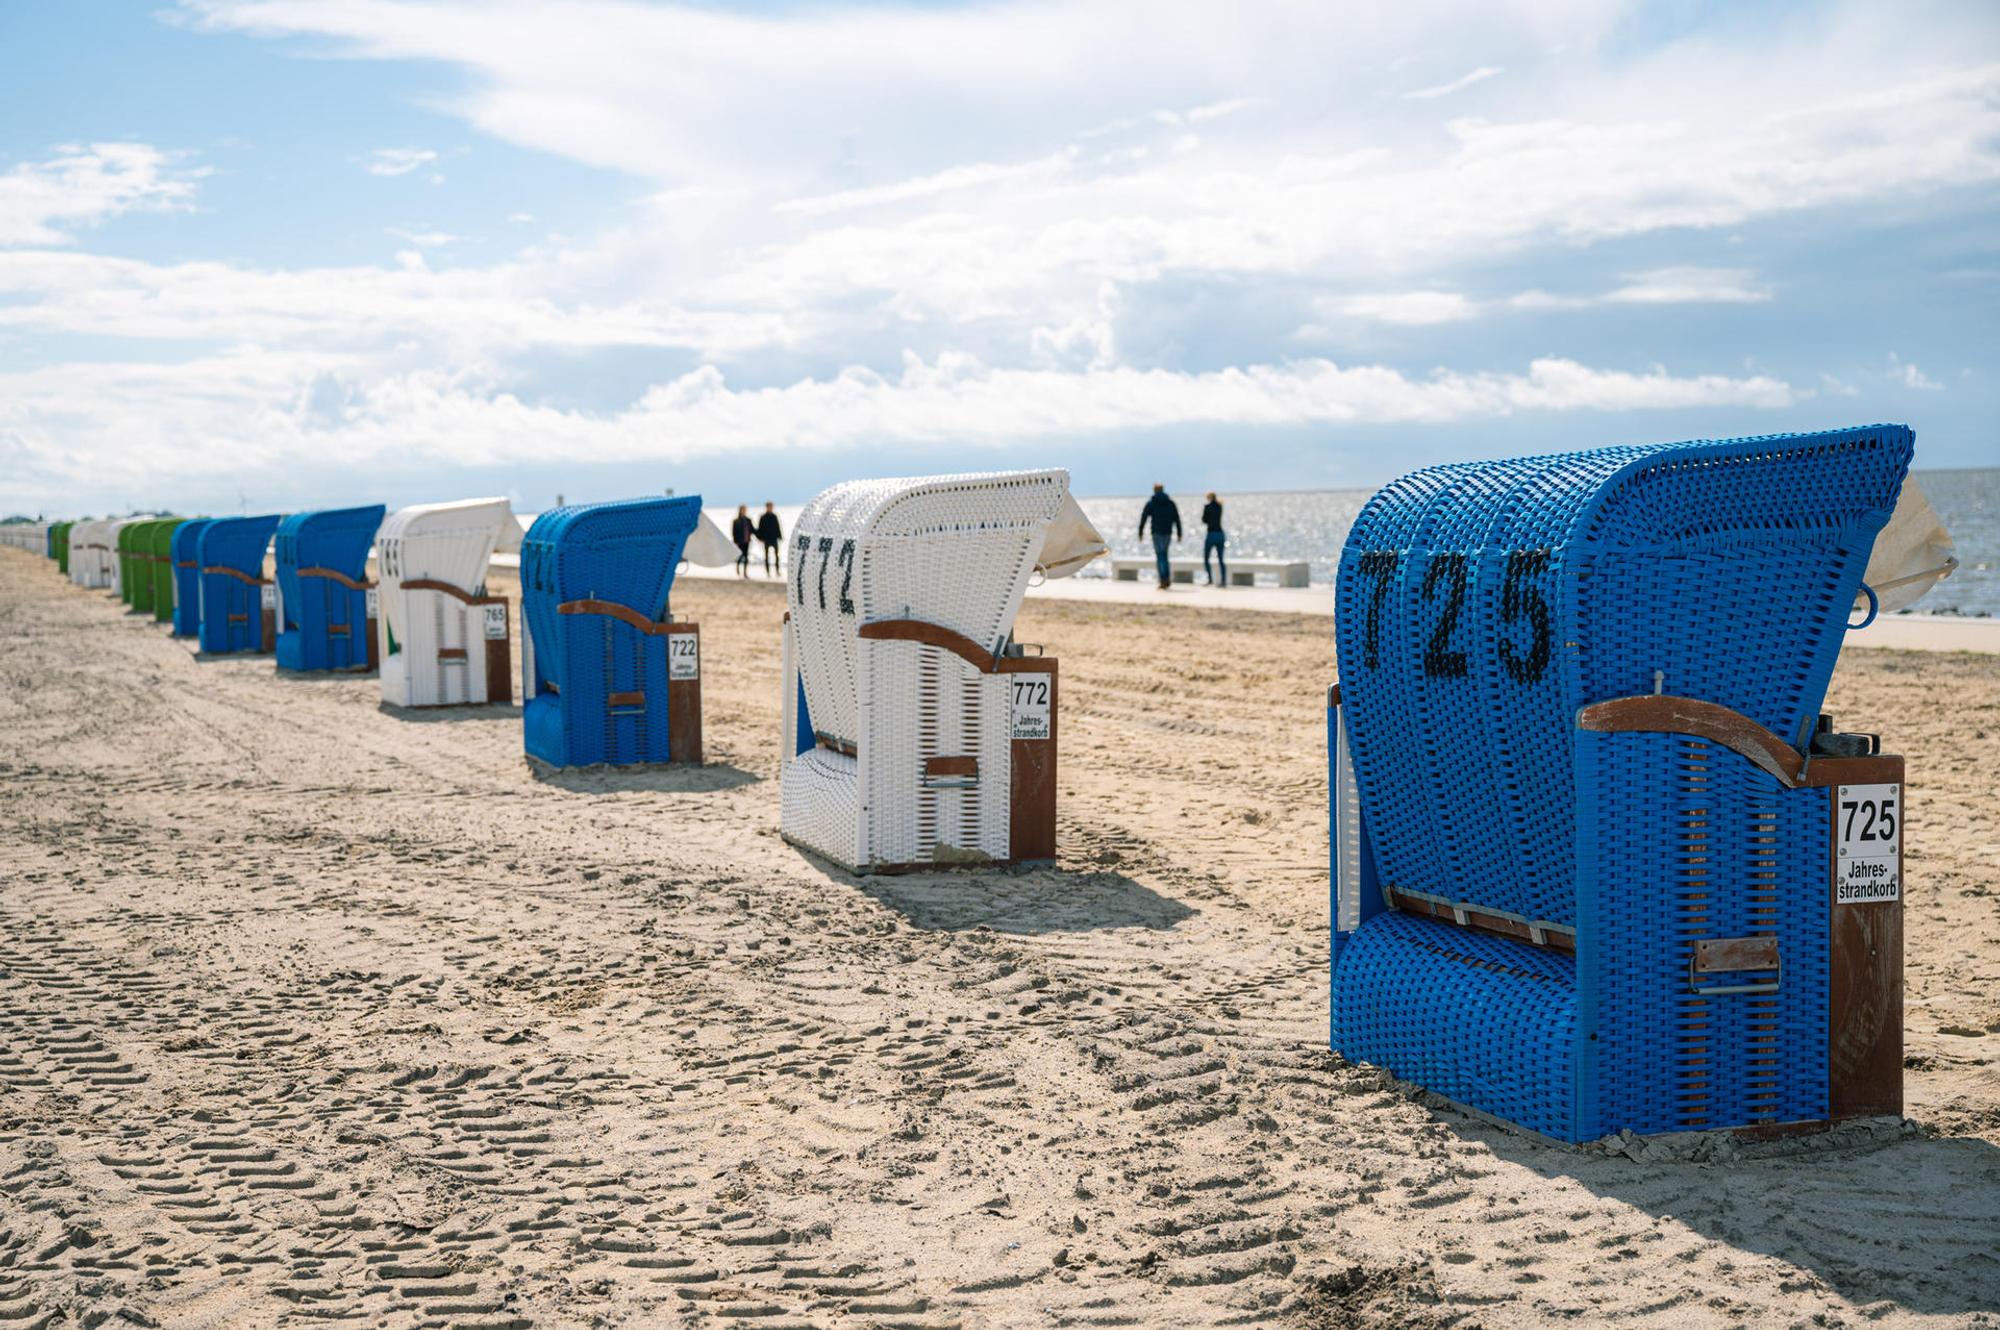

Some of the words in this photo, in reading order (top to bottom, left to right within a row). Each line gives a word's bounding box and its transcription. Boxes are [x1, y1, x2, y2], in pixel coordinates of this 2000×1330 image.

[797, 535, 854, 614] 772
[1358, 551, 1549, 682] 725
[672, 640, 695, 656] 722
[1014, 682, 1047, 705] 772
[1842, 800, 1895, 841] 725
[1849, 860, 1887, 879] Jahres-
[1839, 879, 1896, 899] strandkorb
